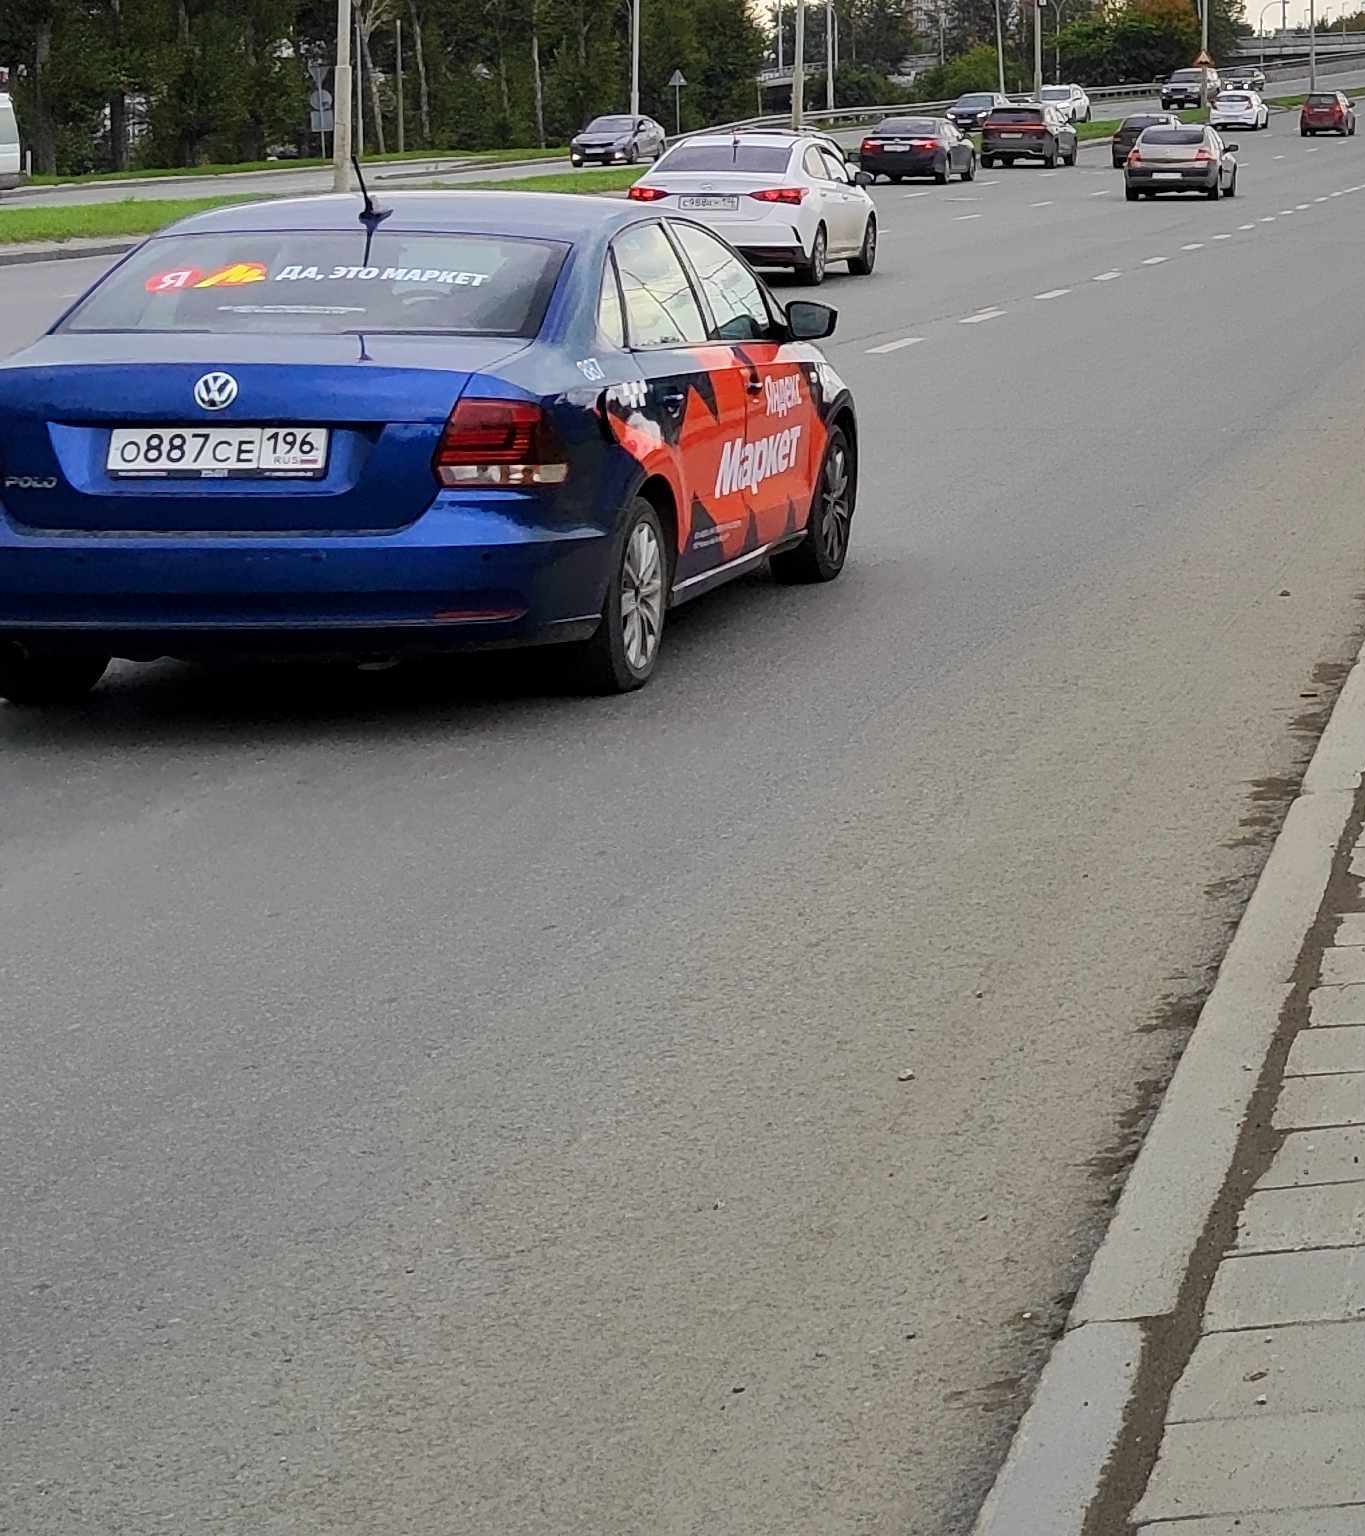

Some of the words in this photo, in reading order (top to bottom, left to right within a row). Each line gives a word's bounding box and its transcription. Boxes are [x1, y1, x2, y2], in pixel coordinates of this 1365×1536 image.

[275, 265, 325, 281] ДА,
[332, 266, 379, 280] ЭТО
[382, 267, 490, 287] МАРКЕТ
[764, 374, 802, 417] Яндекс
[266, 431, 315, 455] 196
[273, 455, 299, 465] RUS
[714, 425, 802, 499] Маркет
[5, 476, 58, 489] POLO
